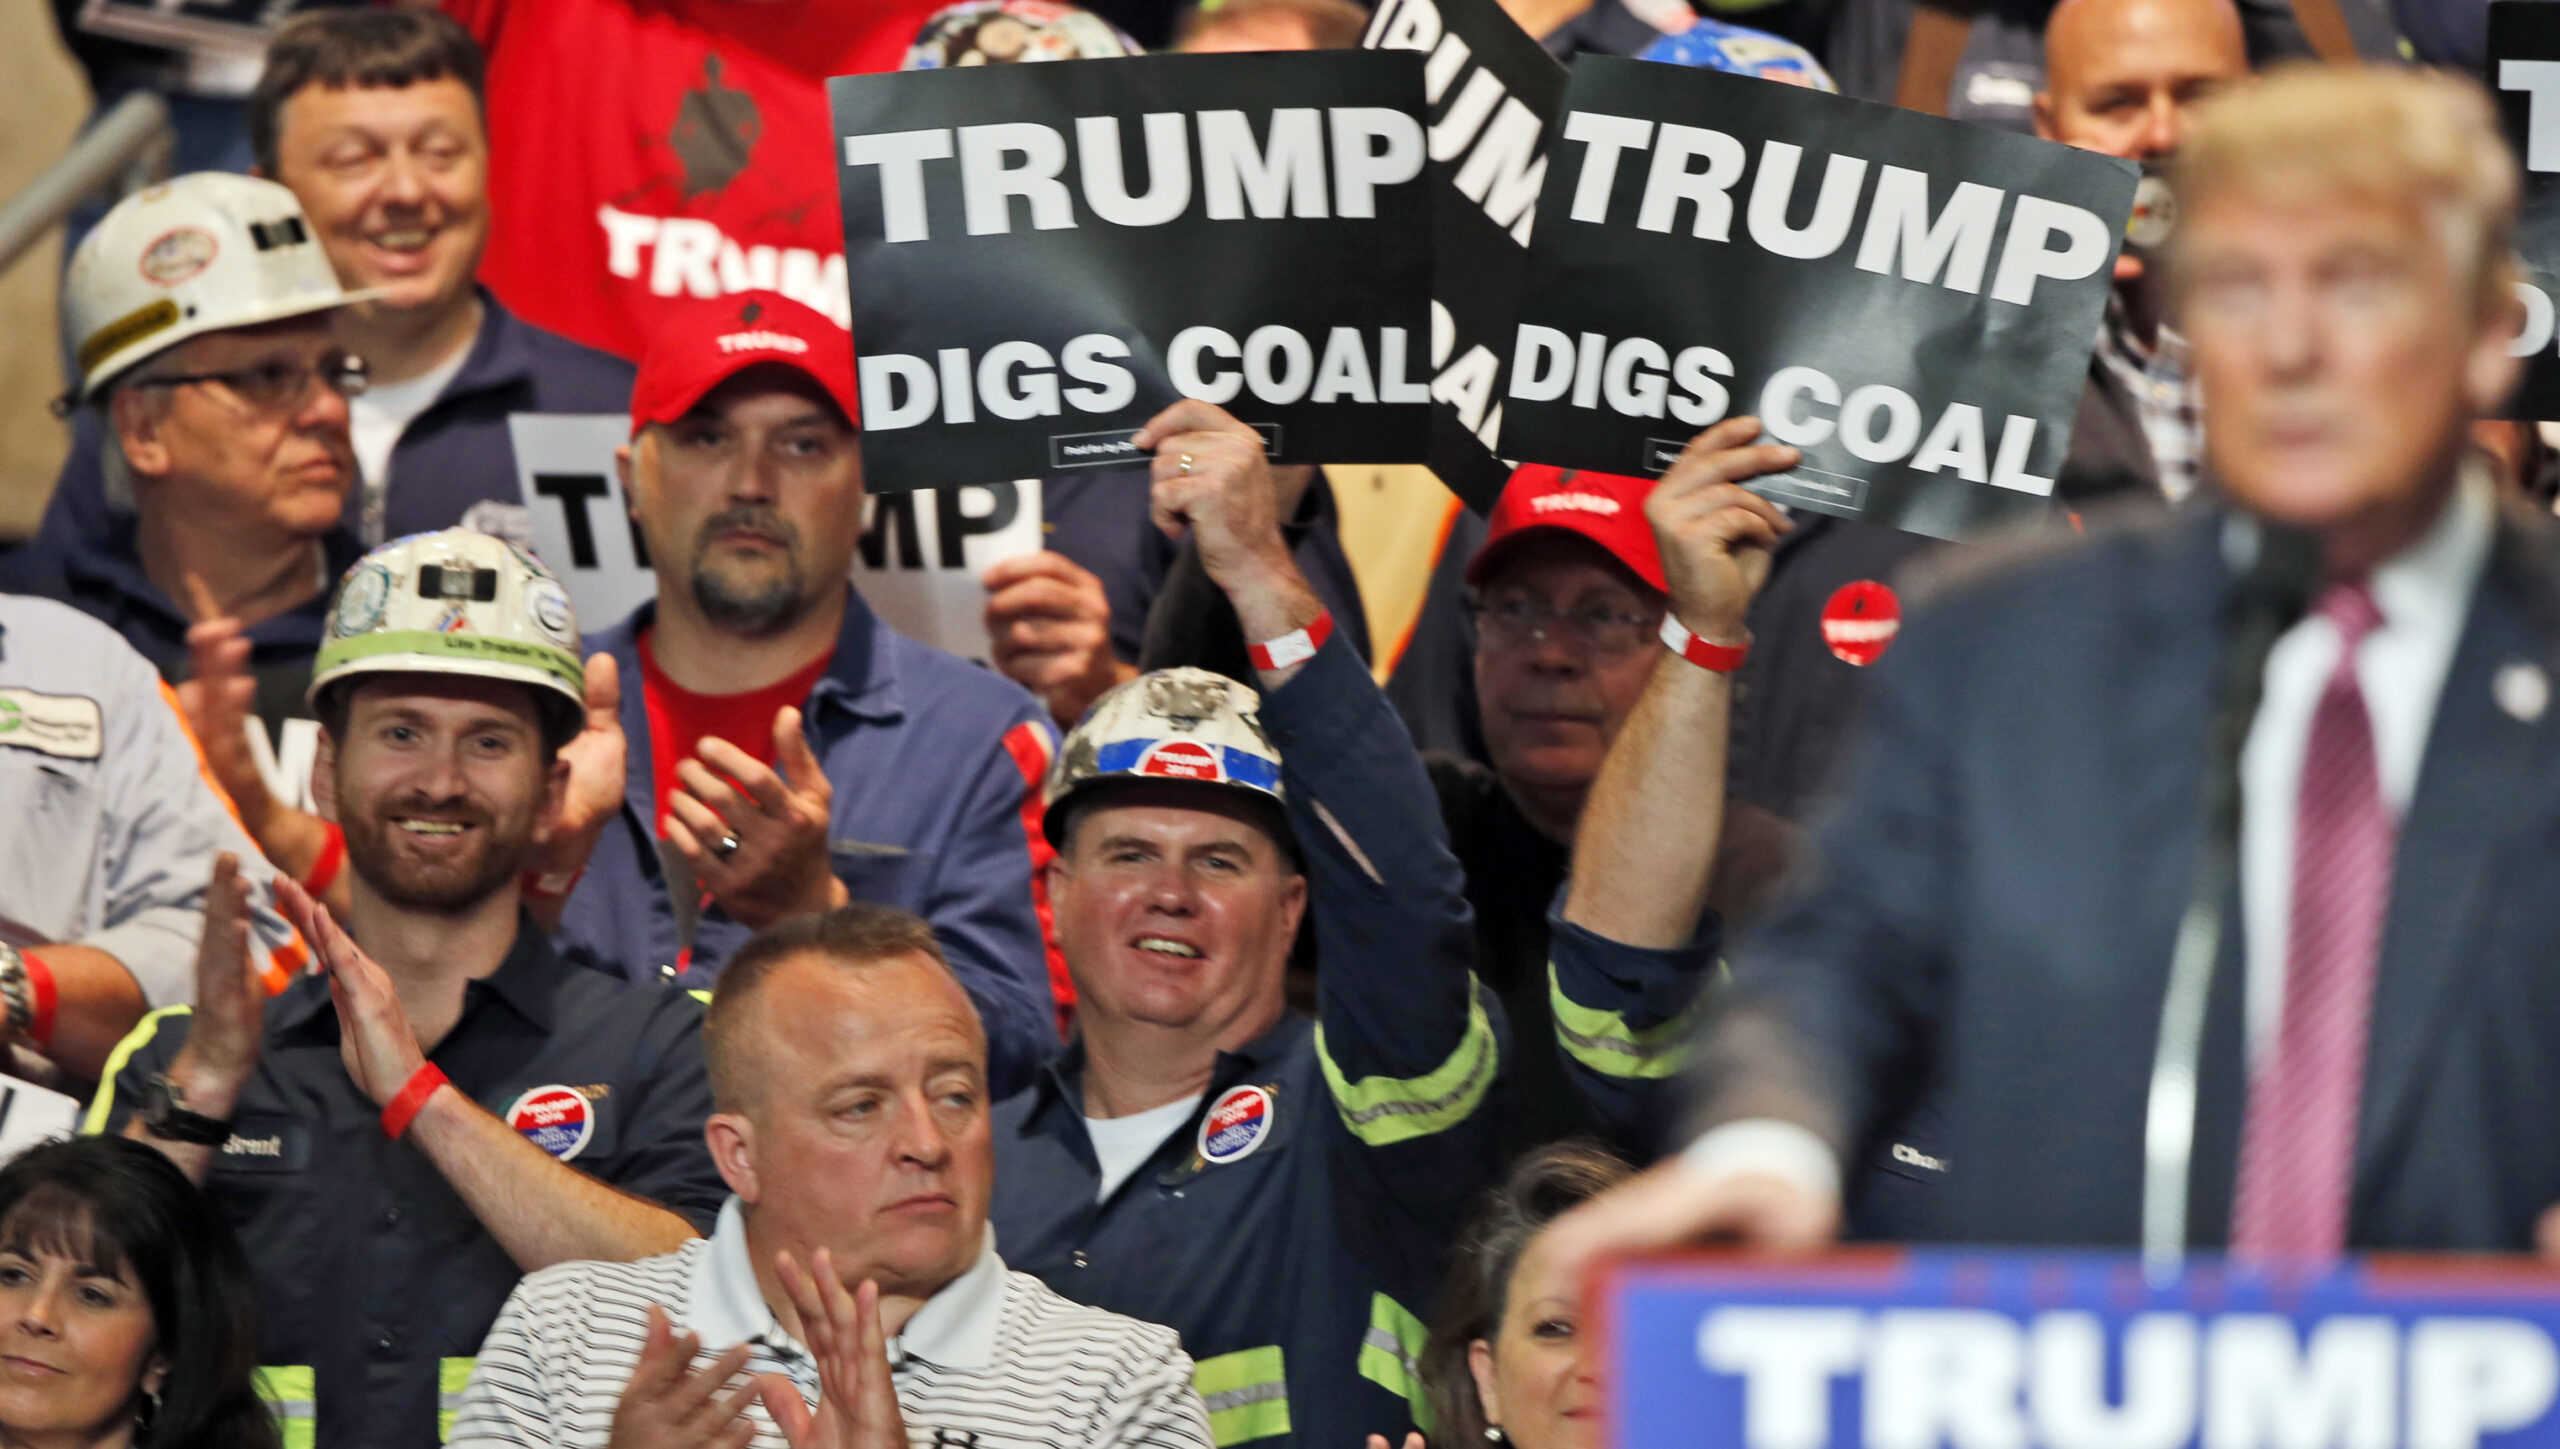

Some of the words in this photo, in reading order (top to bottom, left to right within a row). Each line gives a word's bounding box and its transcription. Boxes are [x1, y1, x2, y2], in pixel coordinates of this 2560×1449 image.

[844, 107, 1426, 243] TRUMP
[1564, 110, 2111, 306] TRUMP
[598, 203, 851, 331] TRUM
[717, 331, 808, 355] TRUMP
[858, 333, 1136, 432] DIGS
[1167, 325, 1431, 404] COAL
[1508, 323, 1734, 426] DIGS
[1759, 366, 2054, 497] COAL
[1530, 492, 1620, 516] TRUMP
[1697, 1304, 2559, 1449] TRUMP
